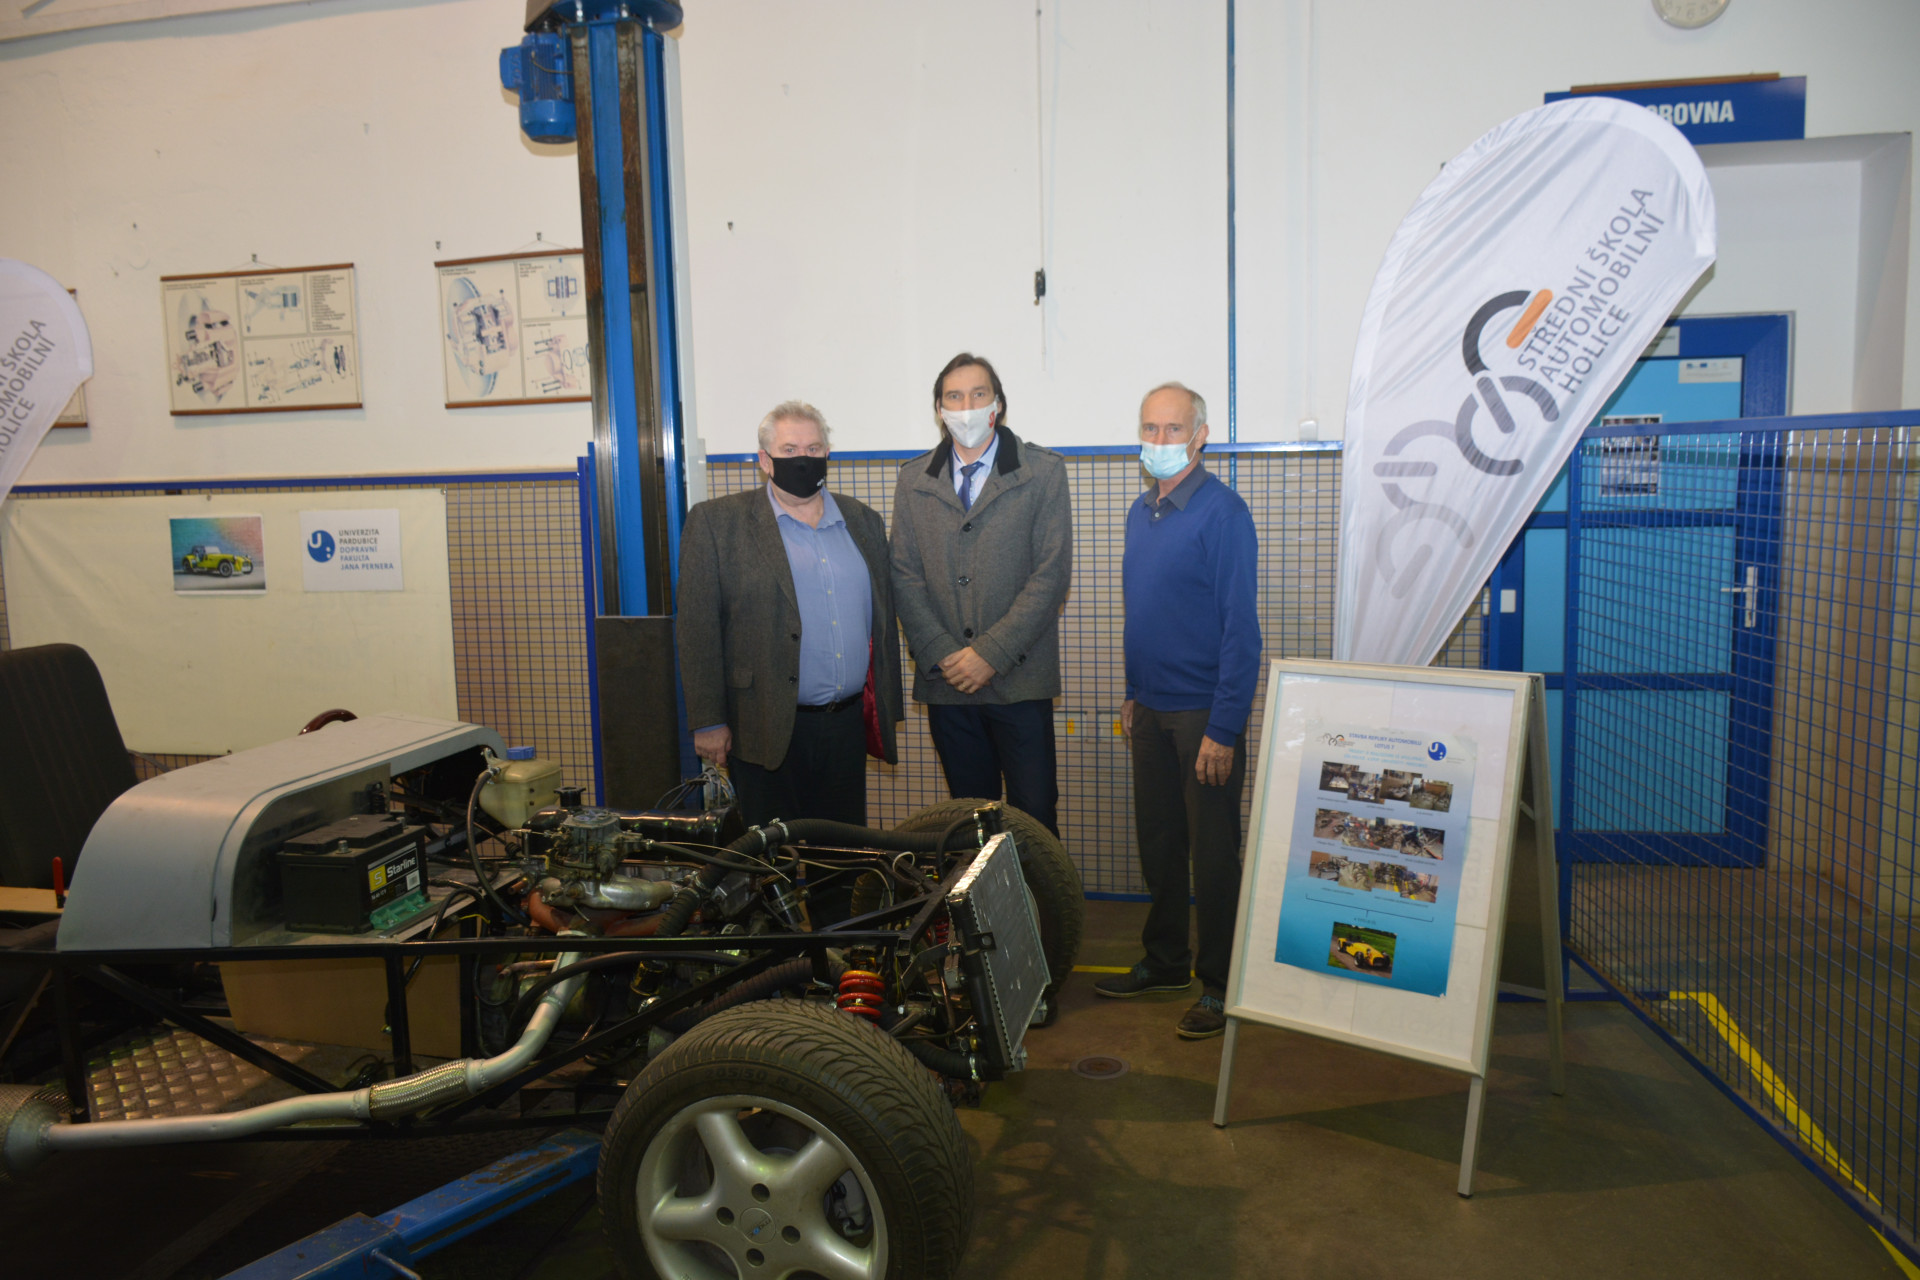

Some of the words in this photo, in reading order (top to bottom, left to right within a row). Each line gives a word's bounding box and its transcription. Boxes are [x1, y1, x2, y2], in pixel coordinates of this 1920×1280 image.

[1517, 265, 1597, 371] STŘEDNÍ
[1585, 188, 1654, 266] ŠKOLA
[1539, 209, 1665, 383] AUTOMOBILNÍ
[0, 319, 47, 371] ŠKOLA
[1557, 304, 1630, 394] HOLICE
[0, 397, 35, 453] OLICE
[339, 528, 380, 536] UNIVERZITA
[339, 537, 378, 545] PARDUBICE
[339, 545, 378, 554] DOPRAVNÍ
[340, 554, 370, 563] FAKULTA
[340, 563, 360, 571] JANA
[361, 562, 394, 570] PERNERA
[387, 857, 416, 878] Starline
